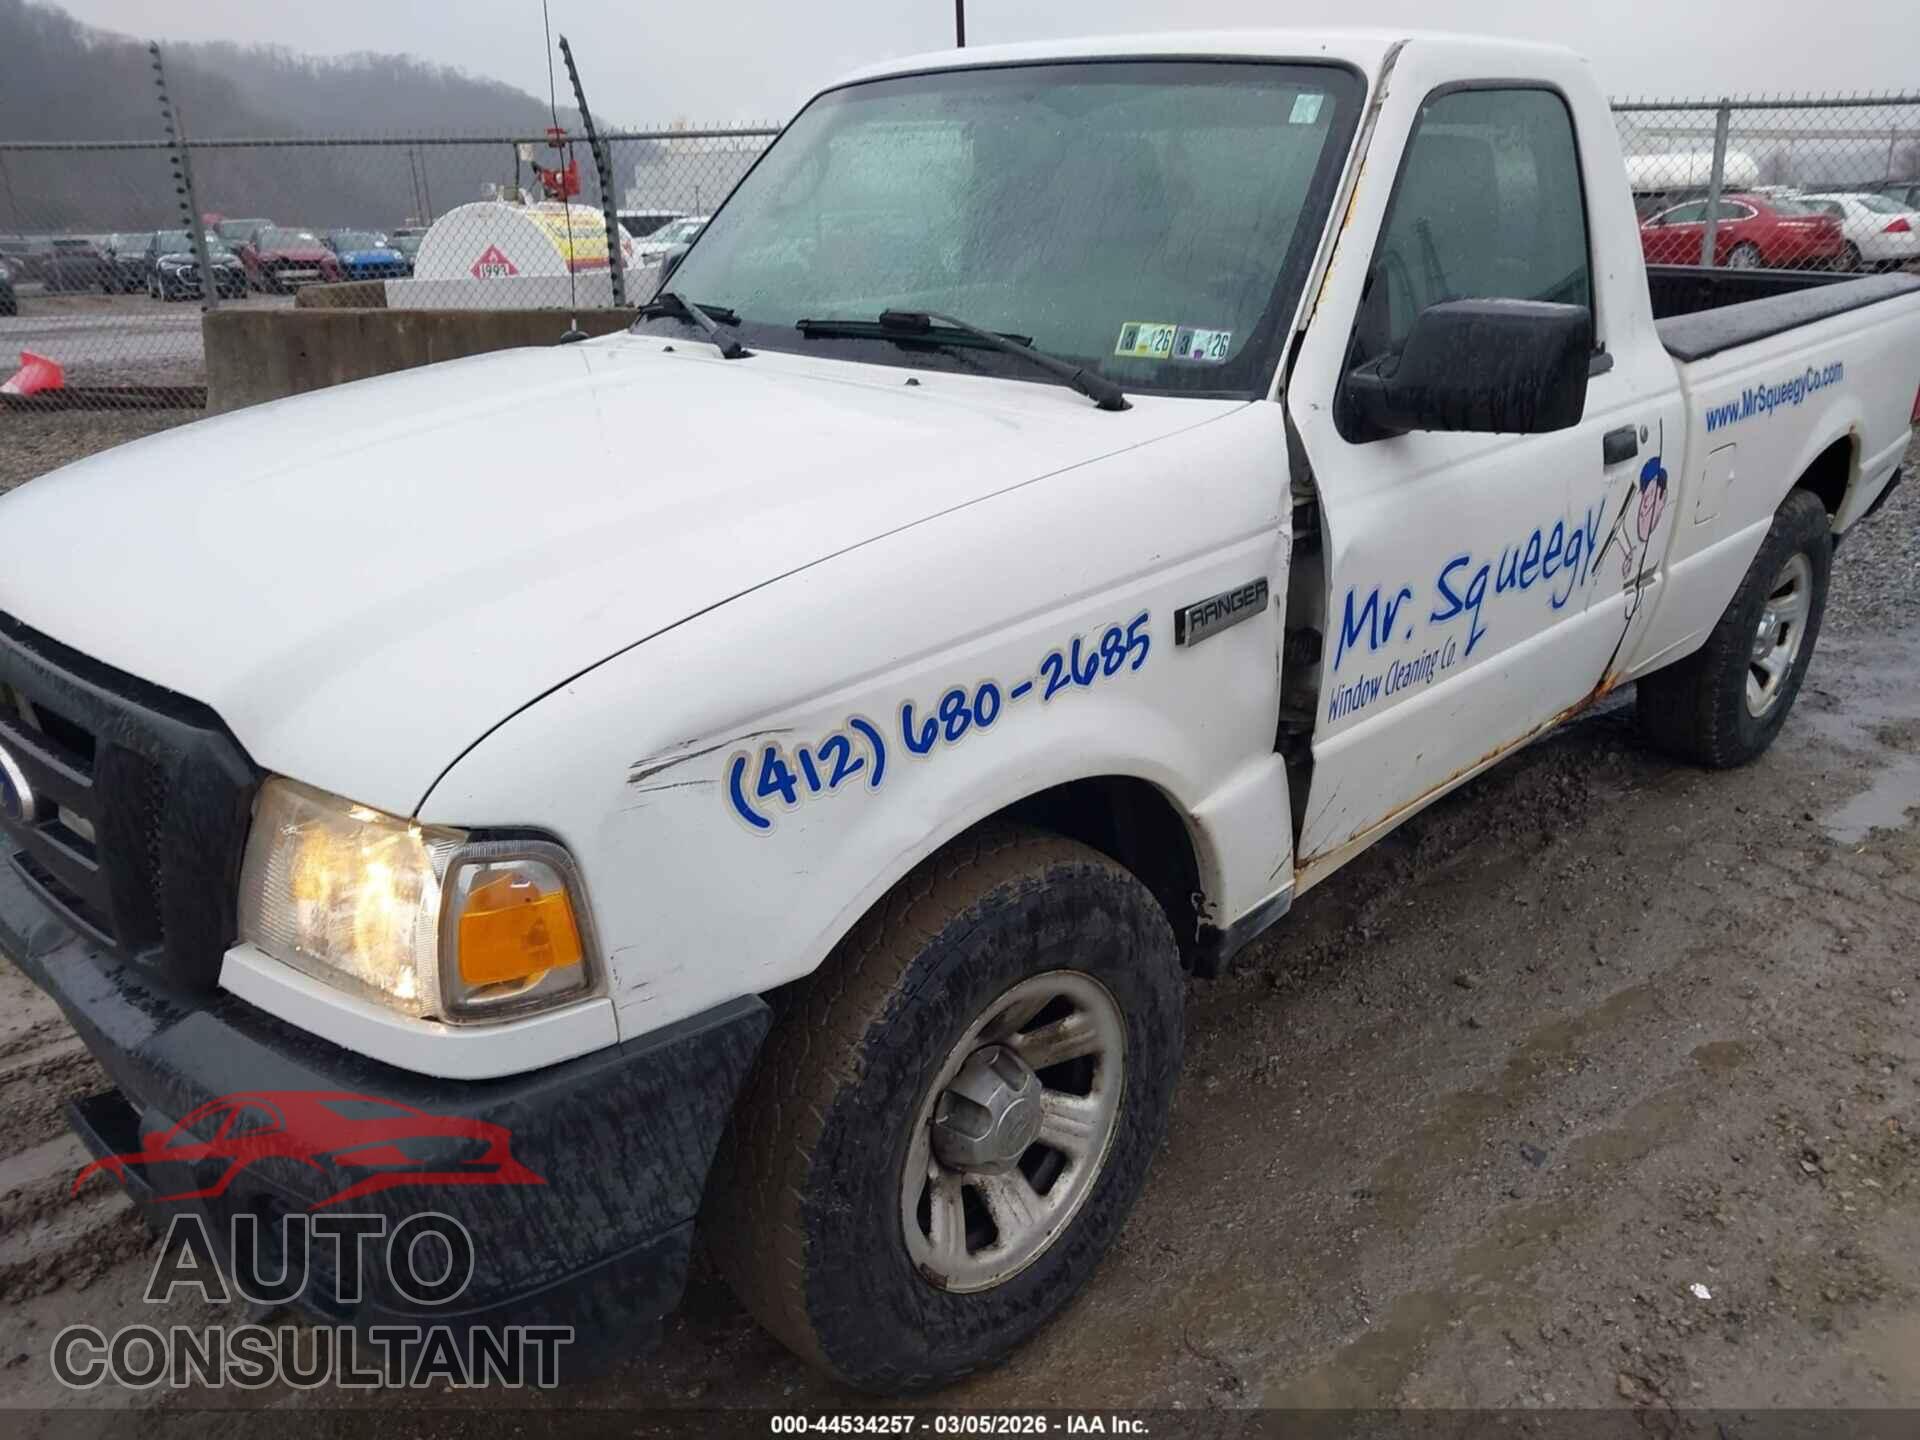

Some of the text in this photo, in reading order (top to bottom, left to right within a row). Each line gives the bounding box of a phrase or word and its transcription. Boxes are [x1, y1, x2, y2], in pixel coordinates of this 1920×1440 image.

[1154, 329, 1173, 352] 26
[1211, 334, 1229, 357] 26
[1706, 362, 1844, 432] www.MrSqueegyCo.com
[1190, 579, 1268, 632] RANGER
[1334, 498, 1605, 672] Mr. Squeegy
[1328, 636, 1456, 724] Window Cleaning Co.
[729, 611, 1151, 828] (412) 680-2685
